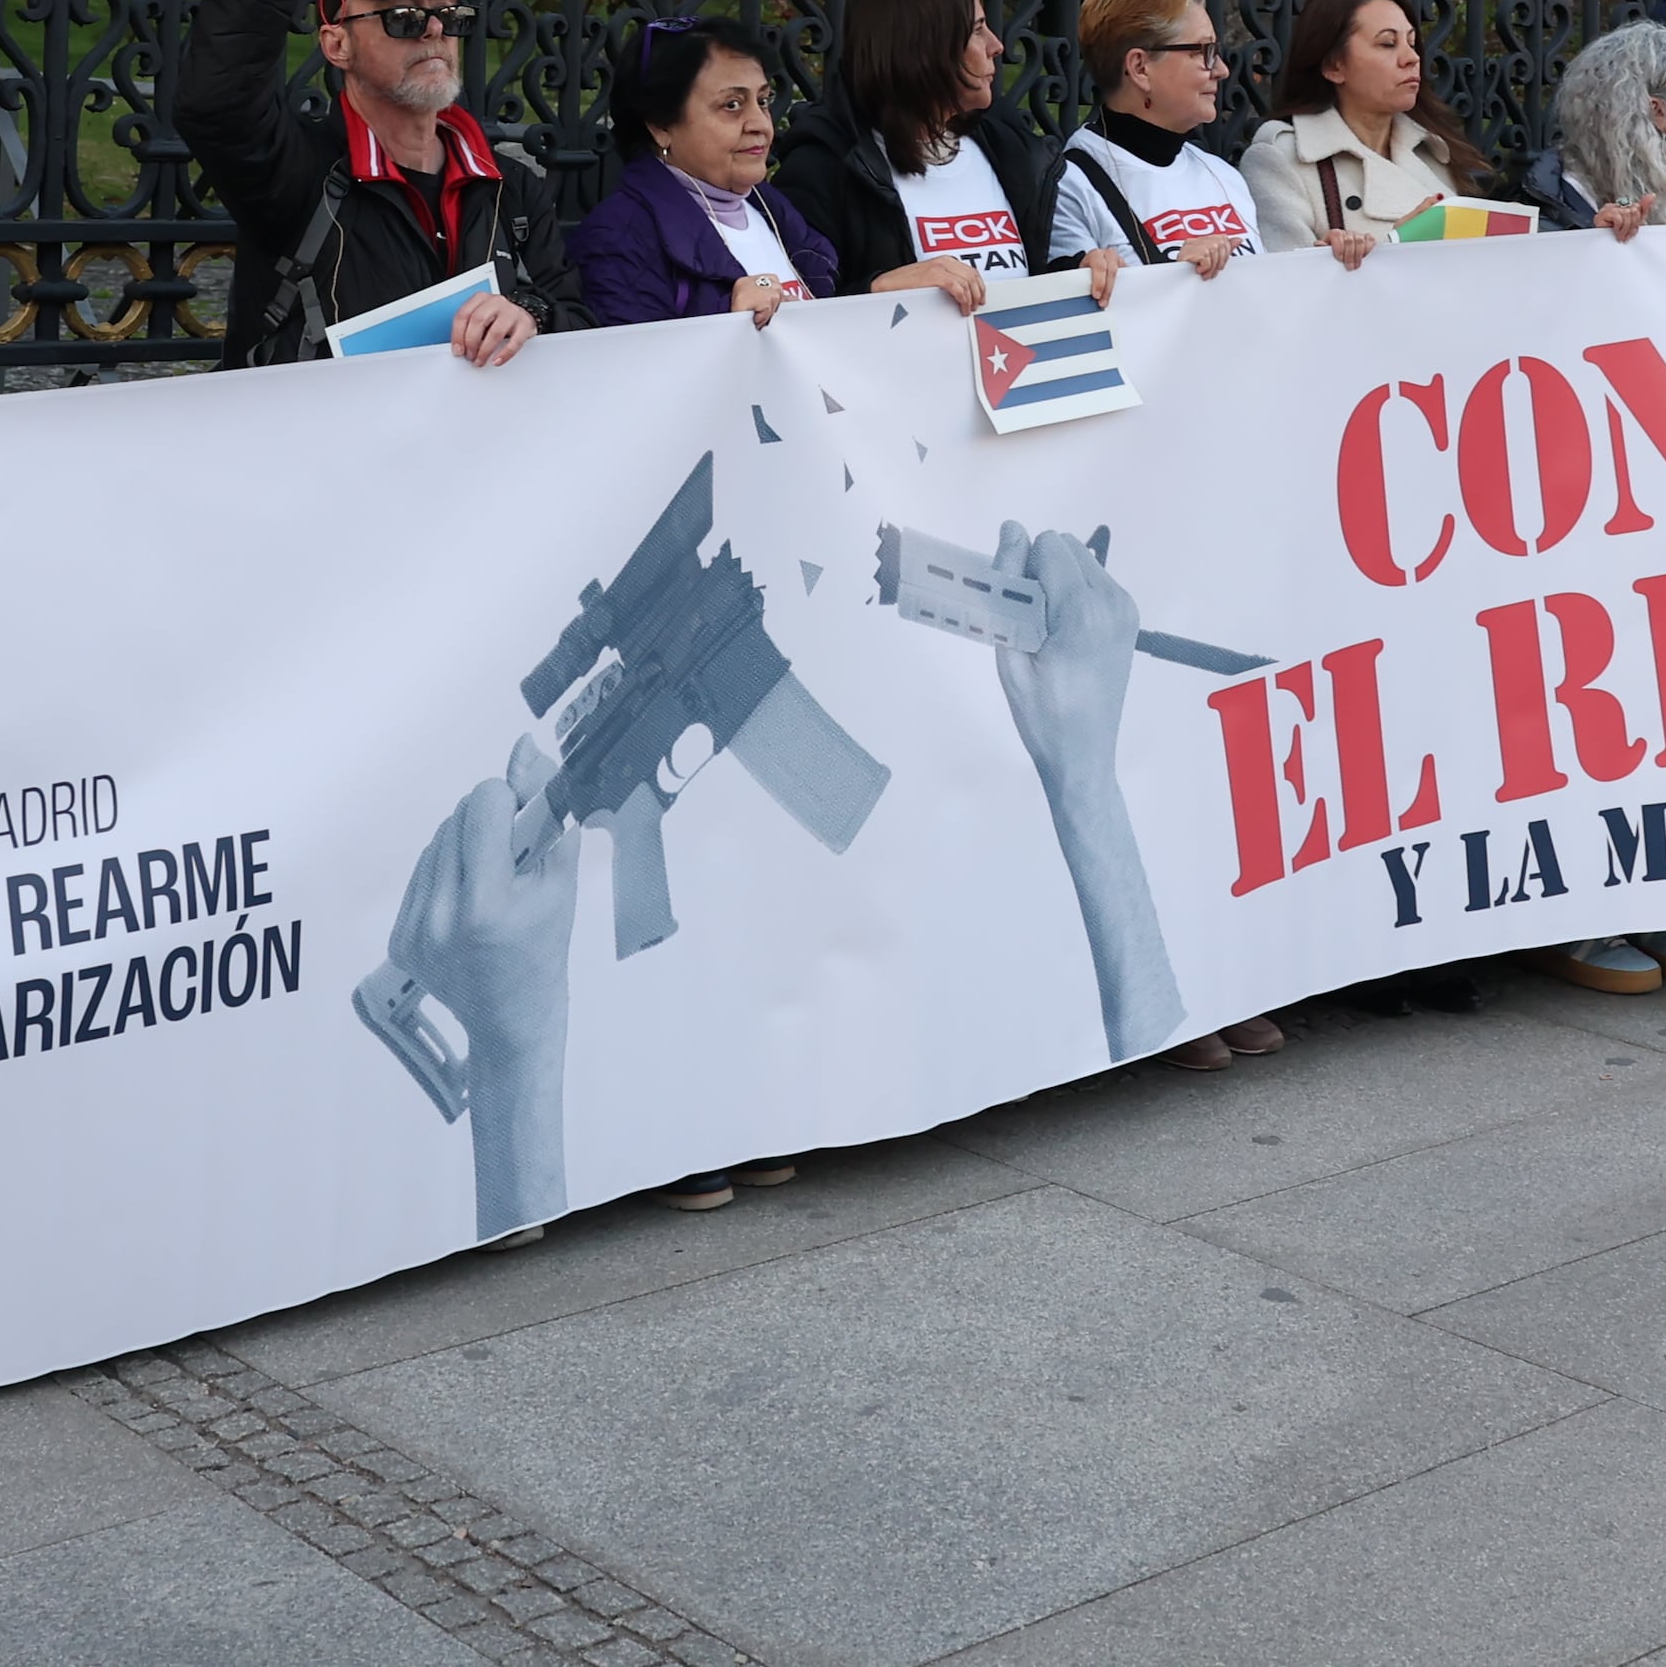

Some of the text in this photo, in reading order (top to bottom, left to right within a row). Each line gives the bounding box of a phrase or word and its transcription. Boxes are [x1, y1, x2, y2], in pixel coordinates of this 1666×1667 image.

[923, 216, 1018, 247] FCK
[951, 249, 1027, 271] TAN
[1153, 208, 1243, 240] FCK
[1205, 636, 1443, 899] EL
[6, 828, 274, 956] REARME
[1379, 840, 1434, 930] Y
[1458, 818, 1569, 913] LA
